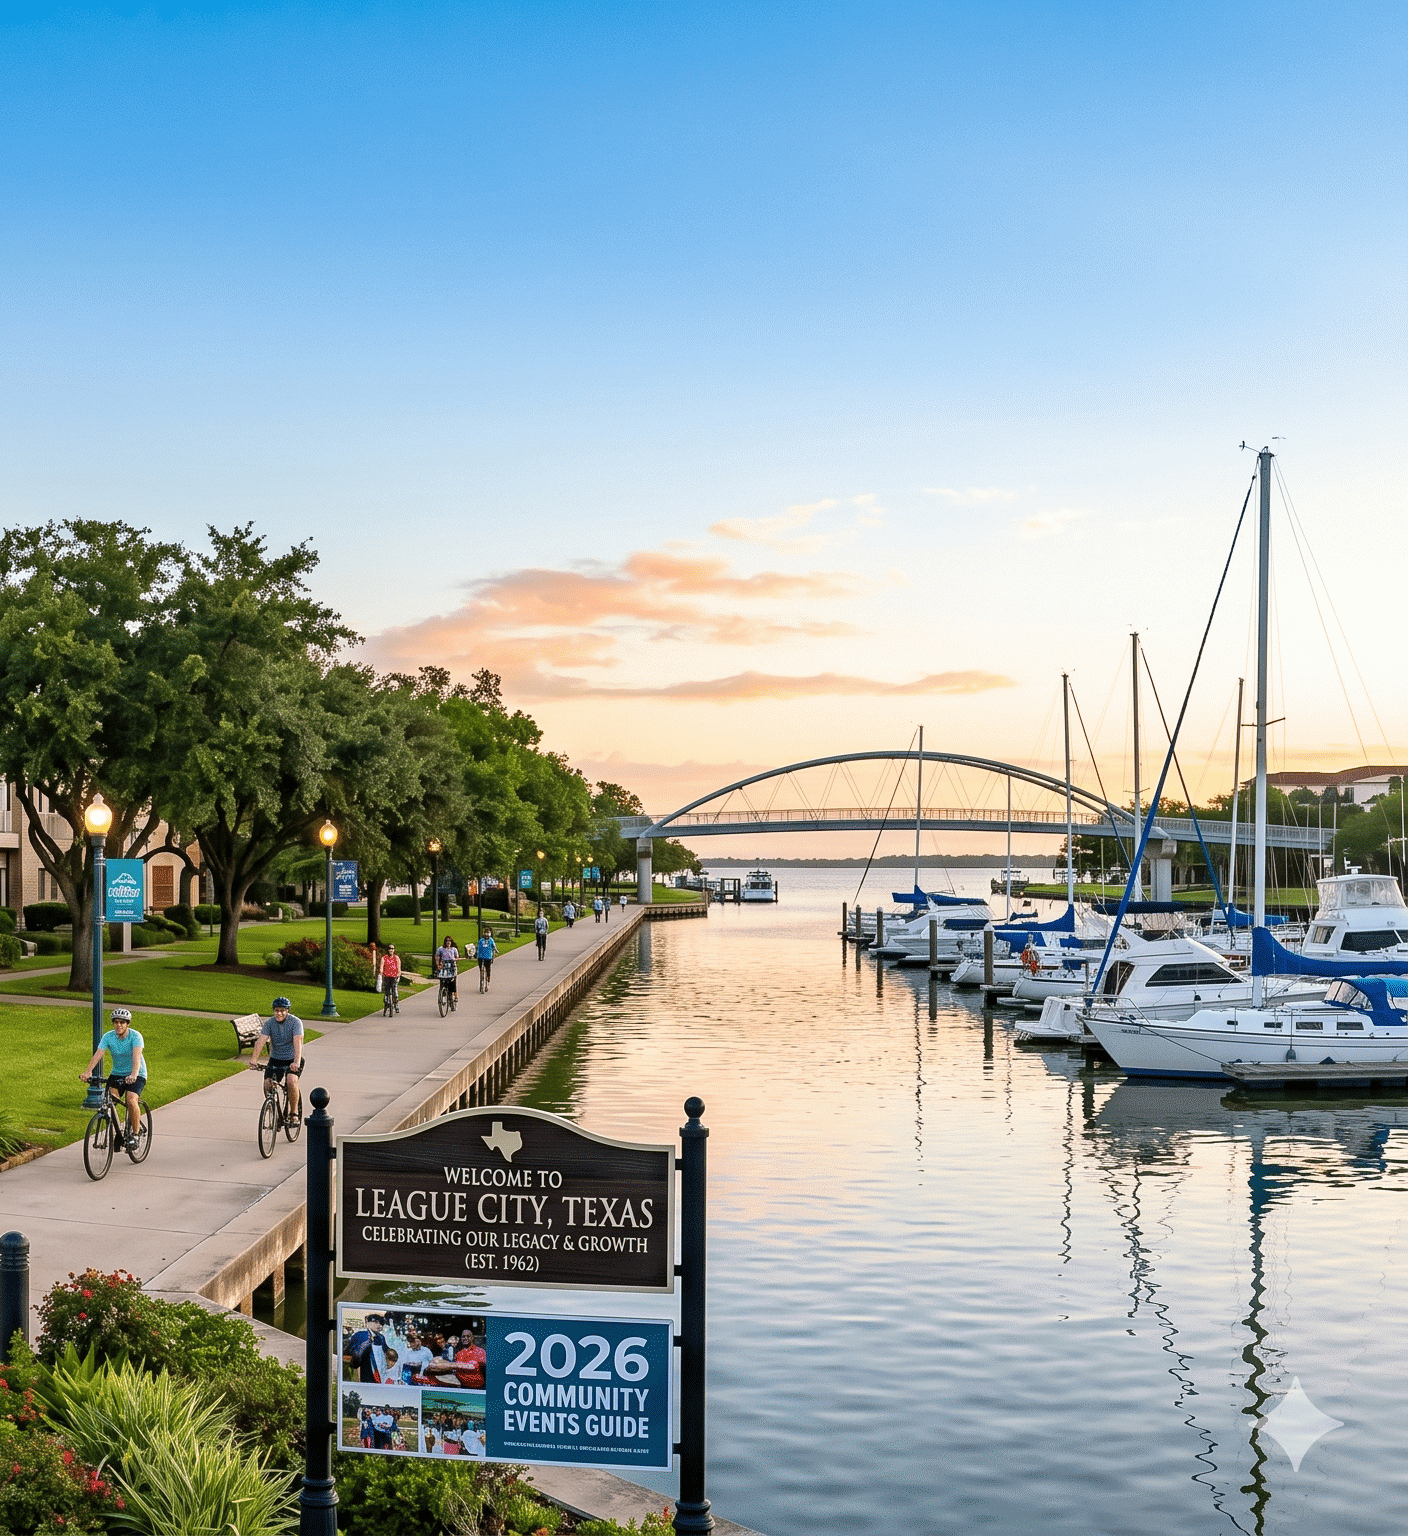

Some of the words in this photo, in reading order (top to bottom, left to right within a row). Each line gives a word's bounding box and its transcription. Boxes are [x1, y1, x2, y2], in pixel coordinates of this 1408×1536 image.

[443, 1166, 532, 1188] WELCOME
[537, 1170, 563, 1189] TO
[355, 1187, 467, 1222] LEAGUE
[477, 1193, 553, 1230] CITY,
[561, 1196, 654, 1229] TEXAS
[361, 1225, 462, 1246] CELEBRATING
[465, 1230, 500, 1248] OUR
[502, 1232, 560, 1251] LEGACY
[563, 1235, 575, 1252] &
[578, 1235, 649, 1254] GROWTH
[464, 1252, 499, 1271] (EST.
[502, 1254, 540, 1273] 1962)
[503, 1331, 650, 1382] 2026
[503, 1381, 650, 1412] COMMUNITY
[503, 1409, 580, 1435] EVENTS
[585, 1414, 650, 1439] GUIDE
